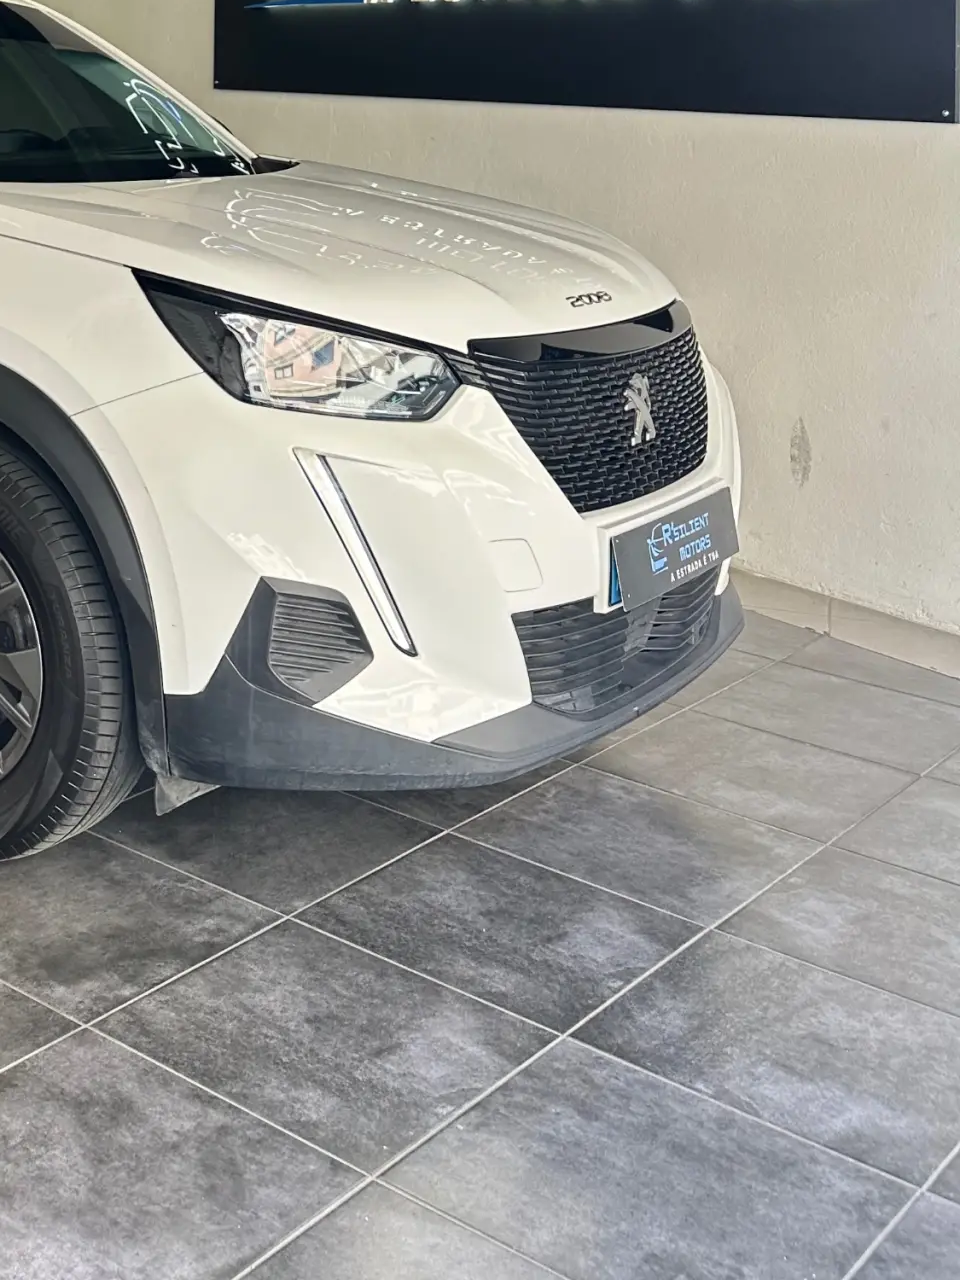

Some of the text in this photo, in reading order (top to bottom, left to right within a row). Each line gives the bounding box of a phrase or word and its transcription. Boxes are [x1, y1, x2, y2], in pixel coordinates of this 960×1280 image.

[565, 291, 613, 308] 2008
[661, 512, 710, 547] R'SILIENT
[679, 534, 712, 562] MOTORS
[670, 572, 676, 583] A
[676, 561, 703, 580] ESTRADA
[708, 549, 720, 564] TUA
